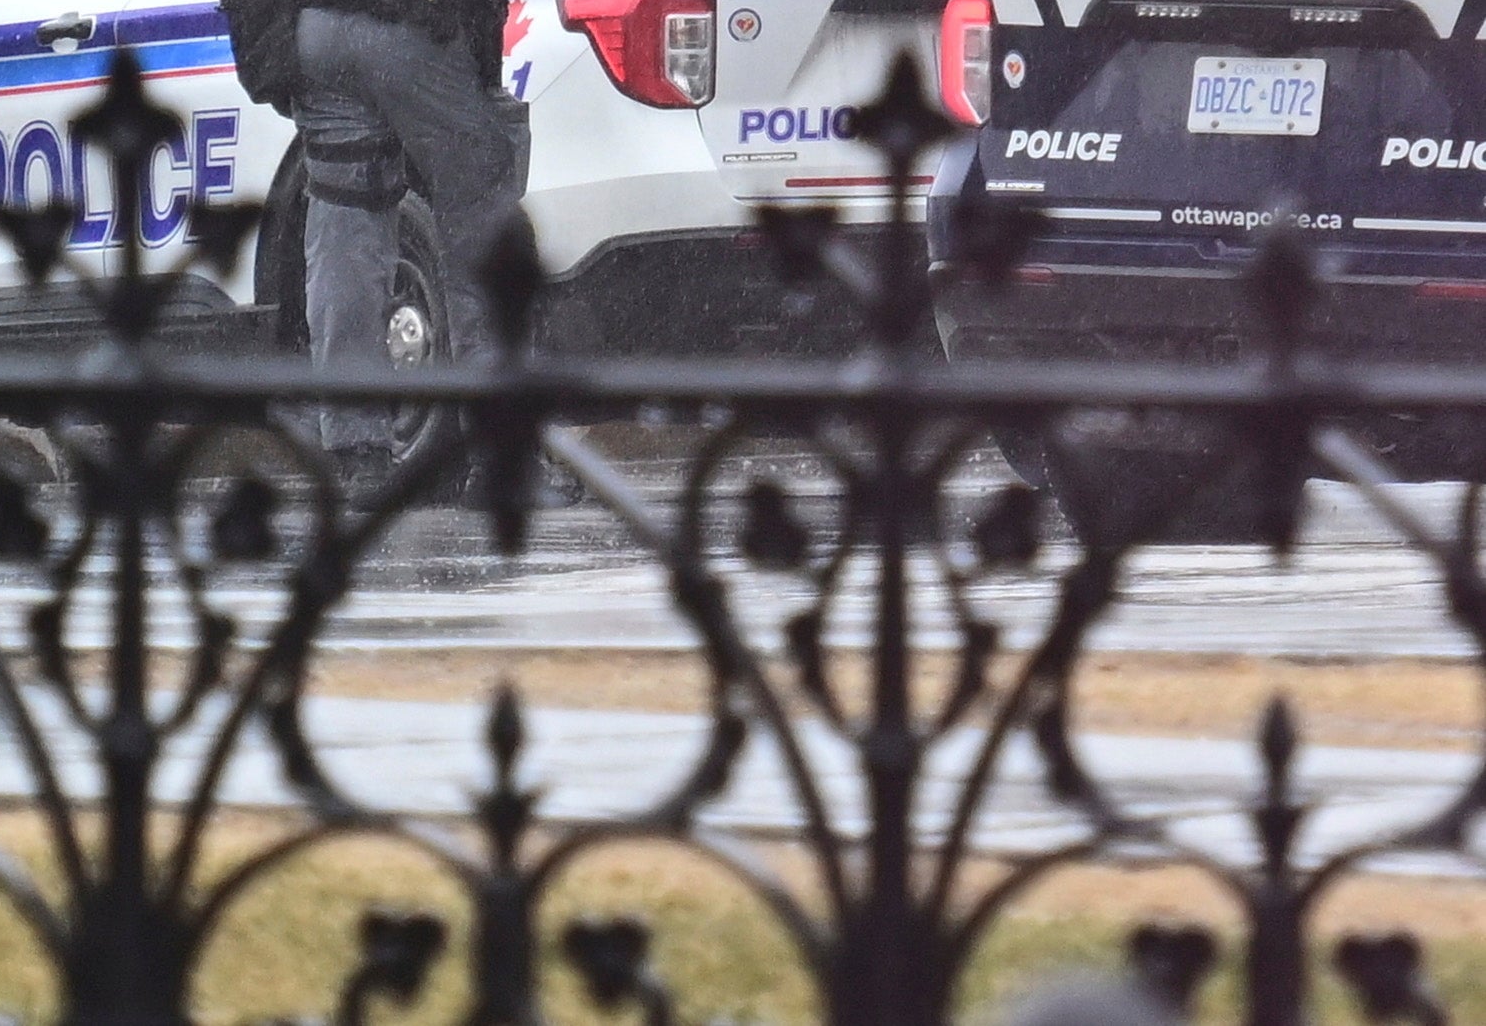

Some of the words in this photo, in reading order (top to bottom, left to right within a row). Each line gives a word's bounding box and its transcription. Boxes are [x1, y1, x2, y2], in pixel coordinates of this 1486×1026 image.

[1195, 76, 1255, 114] DBZC
[1270, 78, 1316, 116] 072
[739, 107, 858, 144] POLIC
[1006, 130, 1122, 162] POLICE
